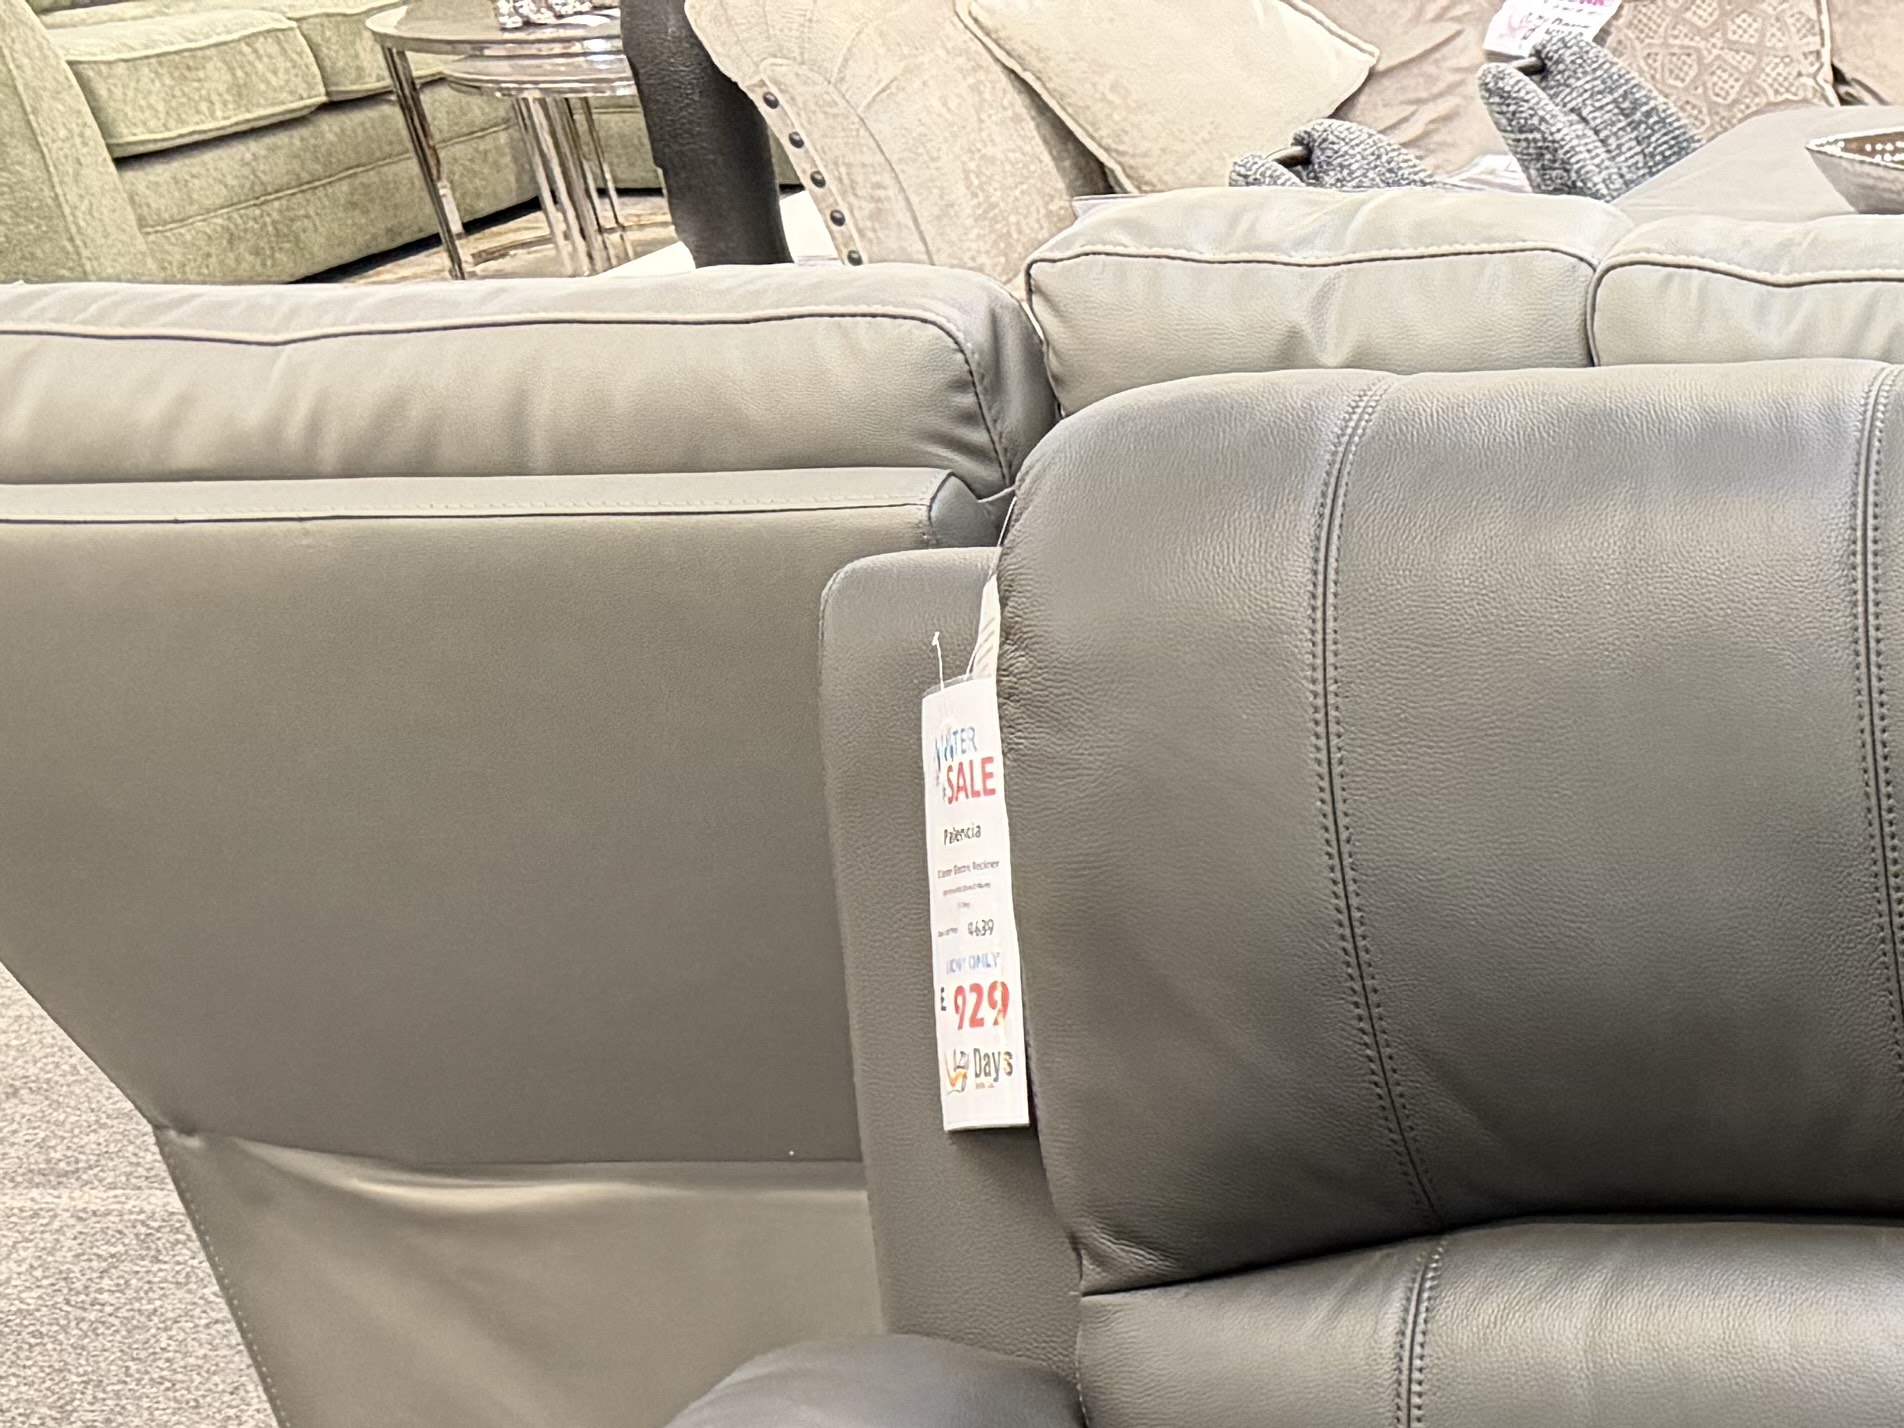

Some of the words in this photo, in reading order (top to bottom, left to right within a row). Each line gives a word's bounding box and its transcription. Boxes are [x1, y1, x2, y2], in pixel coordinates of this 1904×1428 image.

[946, 756, 996, 805] SALE
[953, 980, 1010, 1030] 929
[973, 1047, 1013, 1082] Days
